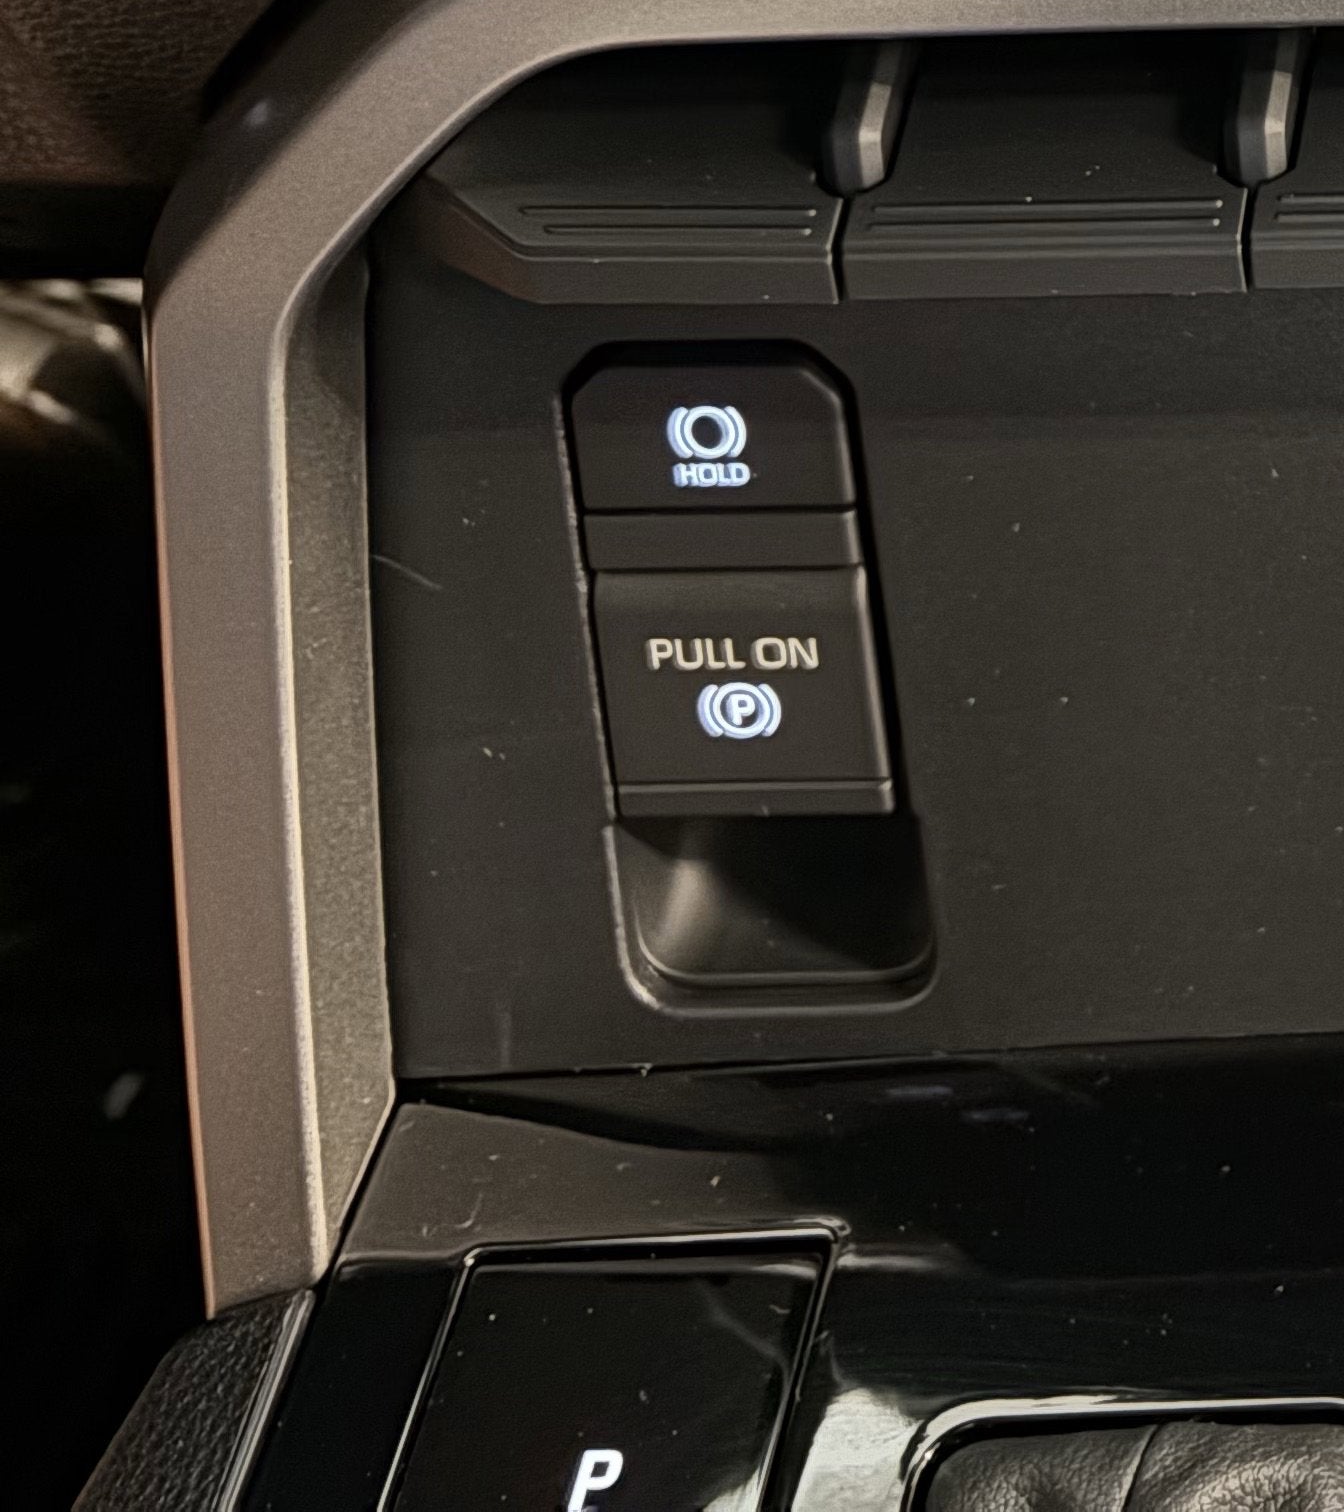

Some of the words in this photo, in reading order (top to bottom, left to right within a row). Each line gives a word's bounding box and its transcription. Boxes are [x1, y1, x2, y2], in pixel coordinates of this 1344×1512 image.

[672, 462, 751, 488] HOLD
[646, 637, 746, 671] PULL
[752, 637, 820, 671] ON
[567, 1448, 624, 1512] P
